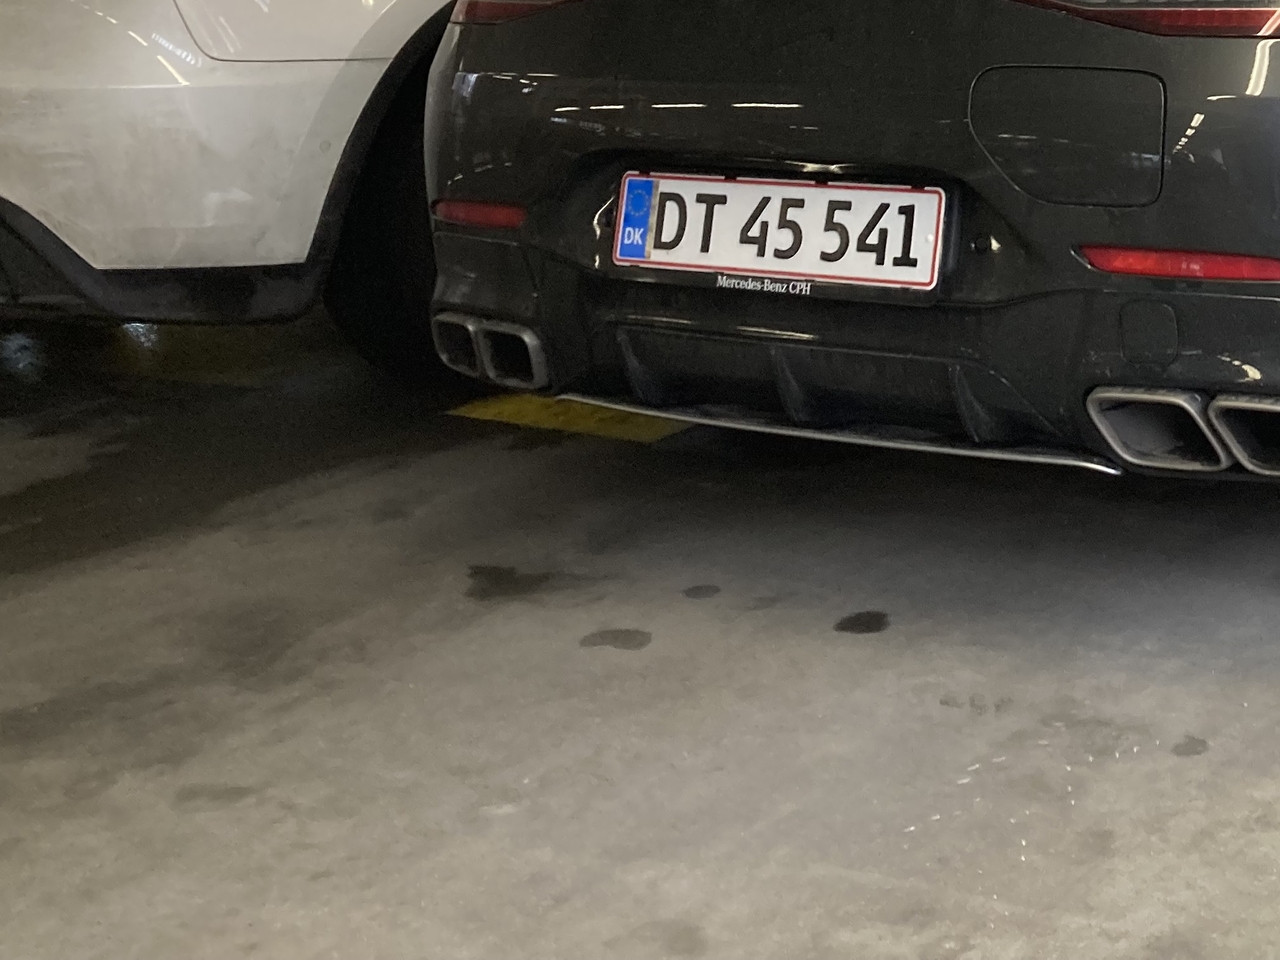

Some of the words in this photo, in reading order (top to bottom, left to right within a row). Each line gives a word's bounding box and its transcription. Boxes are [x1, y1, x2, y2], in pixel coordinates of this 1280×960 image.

[623, 227, 645, 246] DK
[653, 191, 727, 254] DT
[738, 195, 806, 260] 45
[819, 200, 918, 268] 541
[716, 274, 788, 294] Mercedes-Benz
[788, 280, 812, 296] CPH
